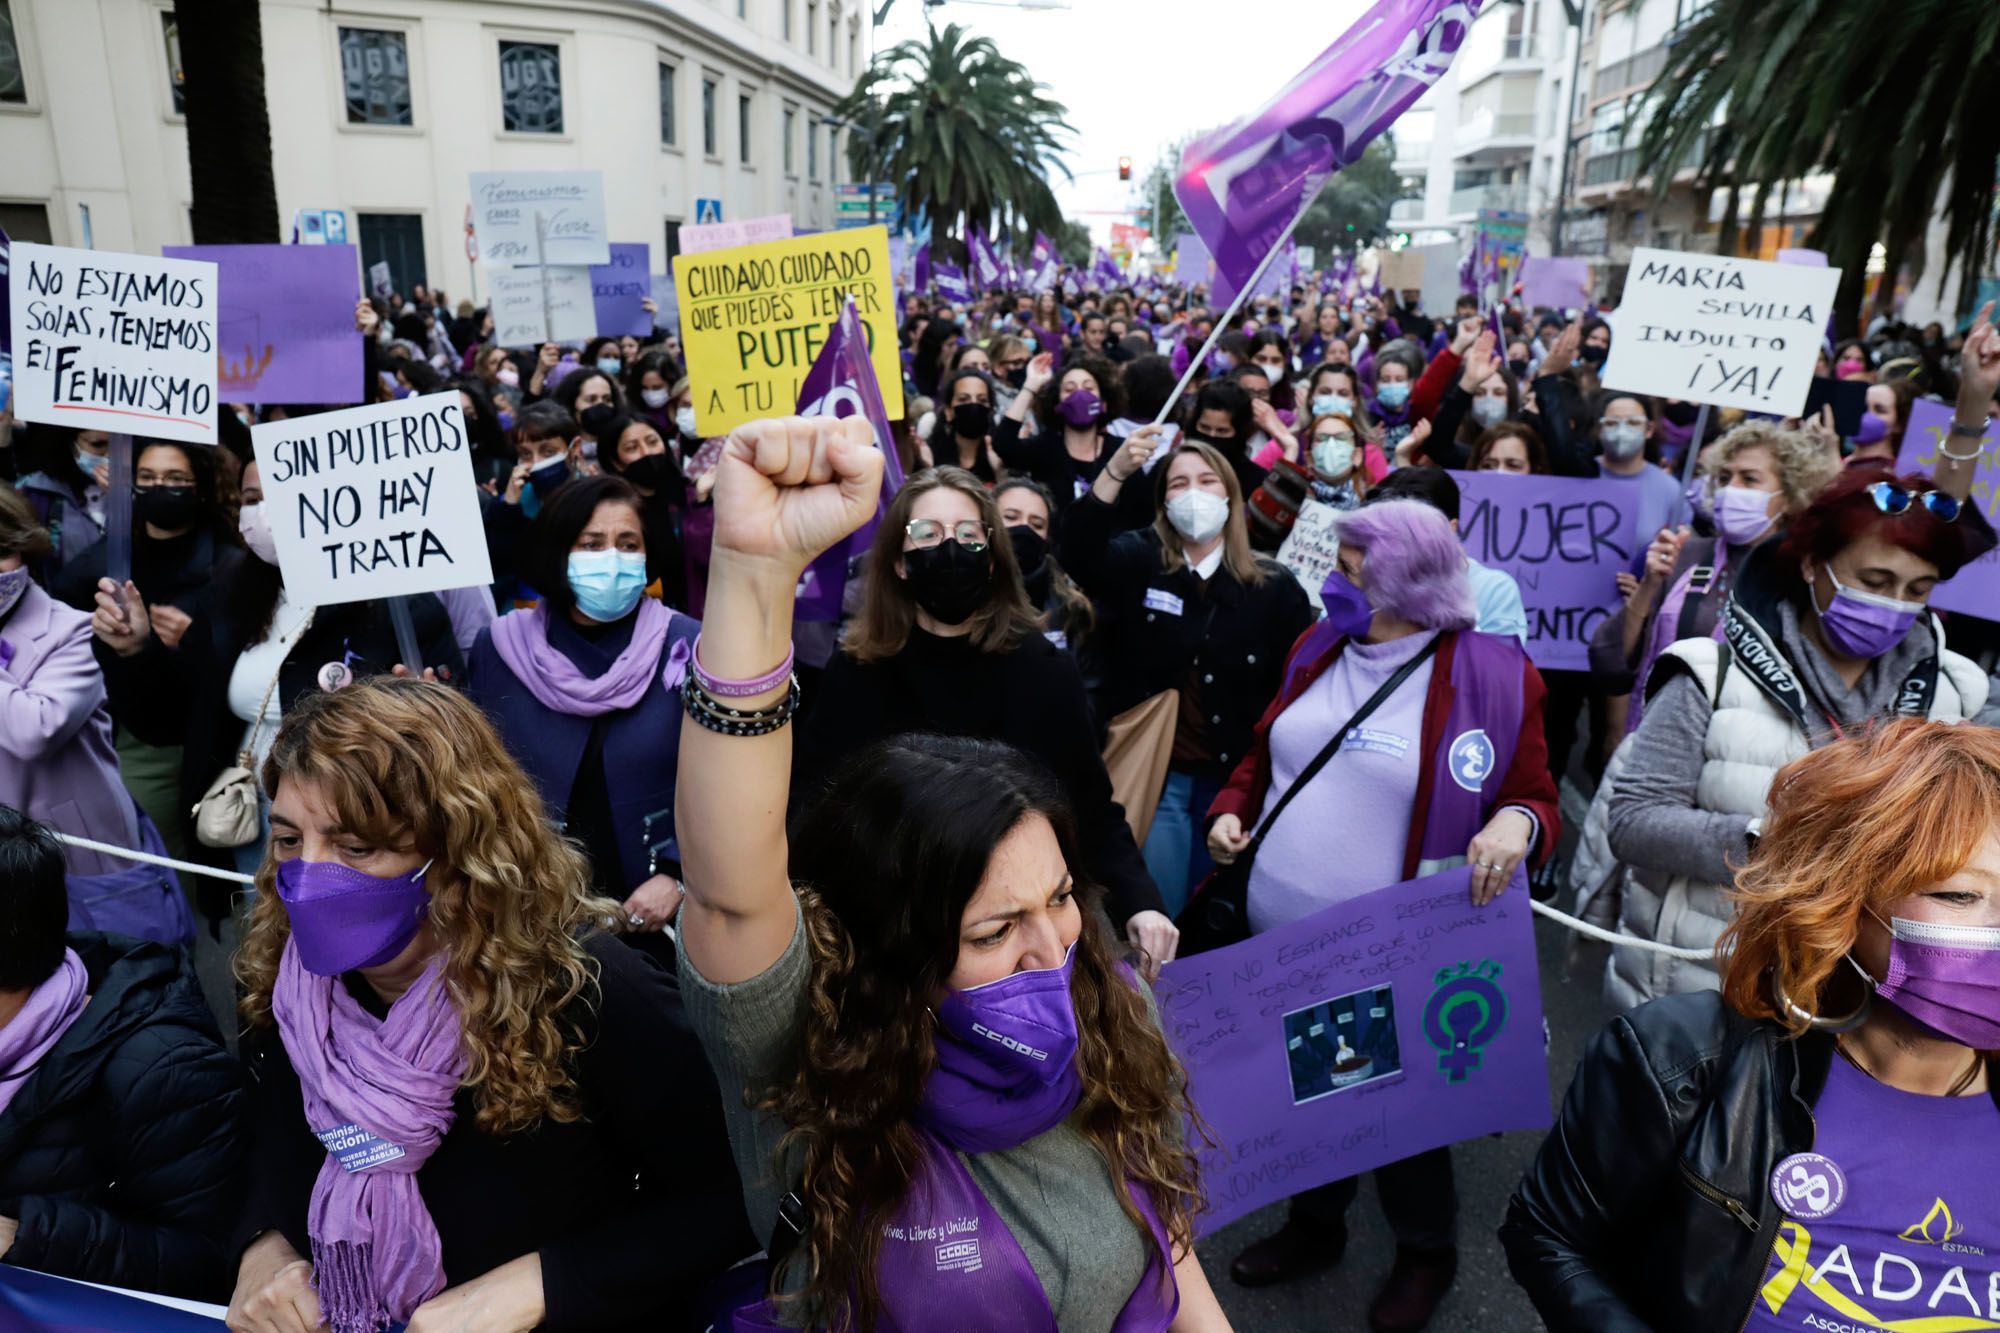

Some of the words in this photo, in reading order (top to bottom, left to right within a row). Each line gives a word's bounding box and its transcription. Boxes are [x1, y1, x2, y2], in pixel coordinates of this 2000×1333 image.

[28, 261, 63, 296] NO
[76, 268, 203, 309] ESTAMOS
[780, 248, 871, 285] CUIDADO
[1639, 262, 1745, 290] MARÍA
[691, 304, 721, 332] QUE
[725, 292, 794, 327] PUEDES
[806, 282, 881, 317] TENER
[1698, 299, 1815, 324] SEVILLA
[110, 311, 211, 353] TENEMOS
[737, 319, 874, 370] PUTEO
[1636, 325, 1786, 351] INDULTO
[708, 388, 725, 415] A
[736, 380, 773, 412] TU
[273, 437, 319, 482] SIN
[327, 405, 461, 469] PUTEROS
[298, 485, 362, 538] NO
[379, 467, 434, 520] HAY
[322, 528, 454, 579] TRATA
[1458, 498, 1629, 564] MUJER
[1737, 632, 1795, 691] CANADA
[1215, 1007, 1239, 1020] EL
[1417, 926, 1434, 940] LO
[1497, 909, 1507, 918] A
[1233, 960, 1263, 986] NO
[1277, 915, 1376, 966] ESTAMOS
[353, 1146, 400, 1168] IMPARABLES
[371, 1142, 396, 1154] JUNTA
[909, 1225, 936, 1241] Libres
[939, 1226, 945, 1242] y
[946, 1216, 979, 1235] Unidas!
[1942, 1242, 1985, 1256] ESTATAL
